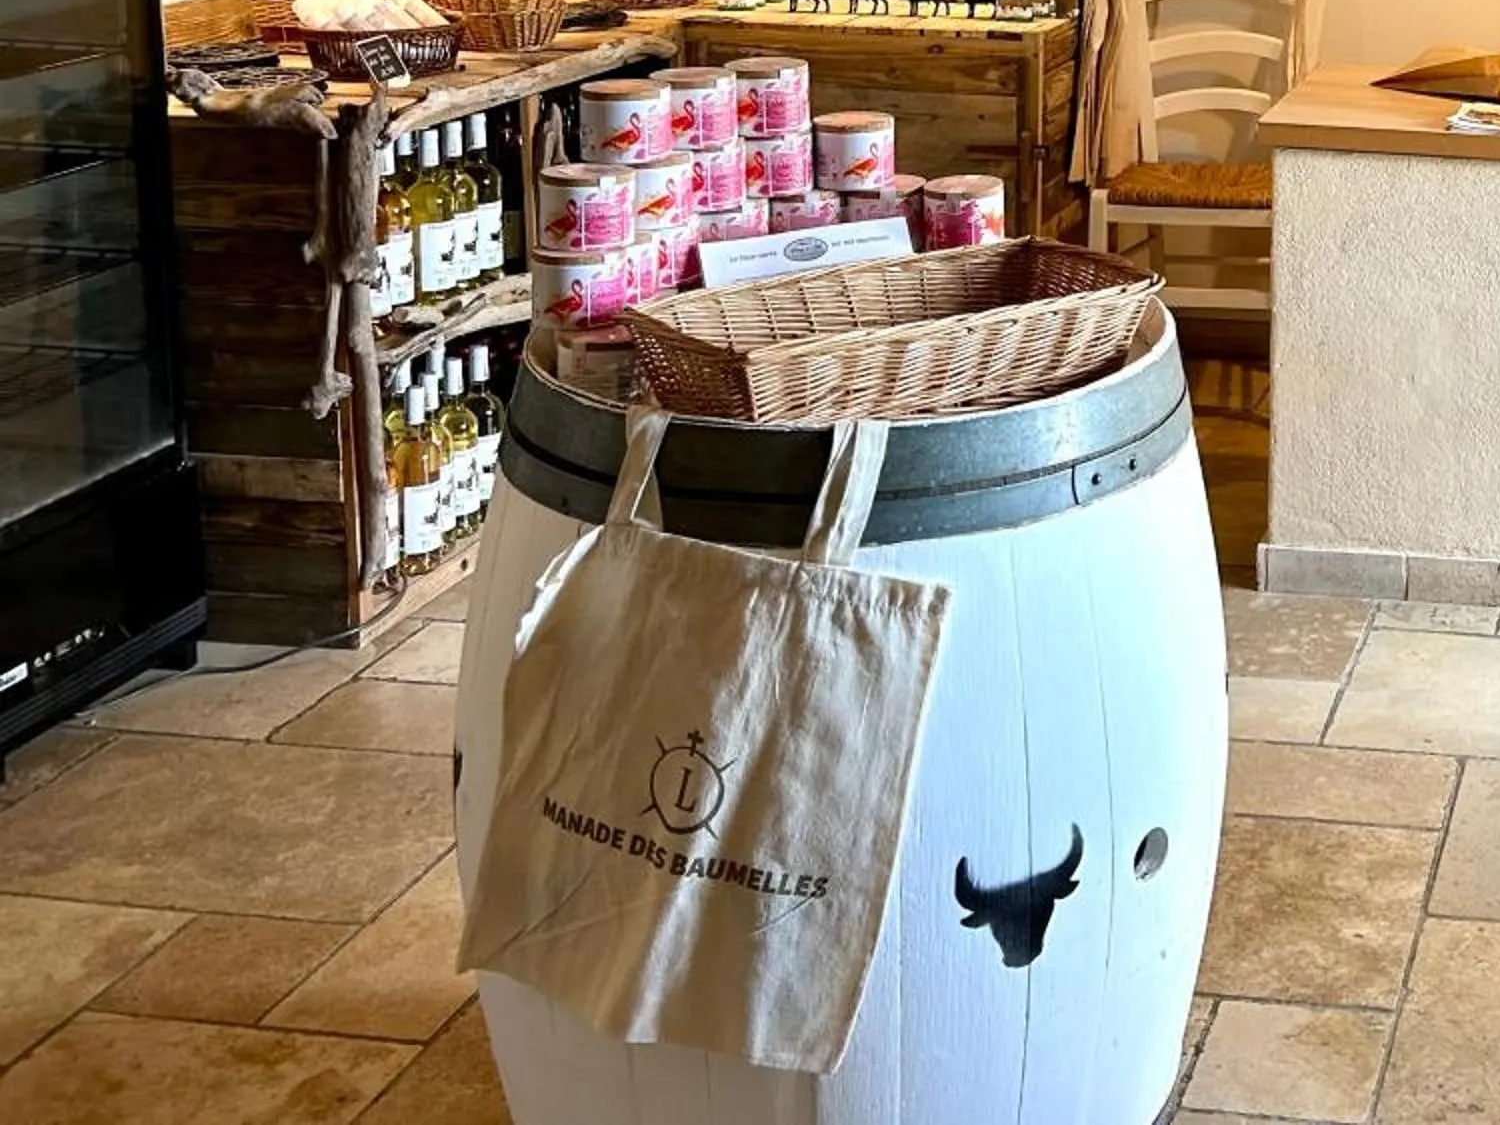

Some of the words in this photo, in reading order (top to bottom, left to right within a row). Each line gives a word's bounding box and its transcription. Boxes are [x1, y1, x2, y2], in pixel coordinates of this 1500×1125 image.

[674, 766, 697, 813] L
[542, 797, 626, 850] MANADE
[669, 852, 829, 898] BAUMELLES
